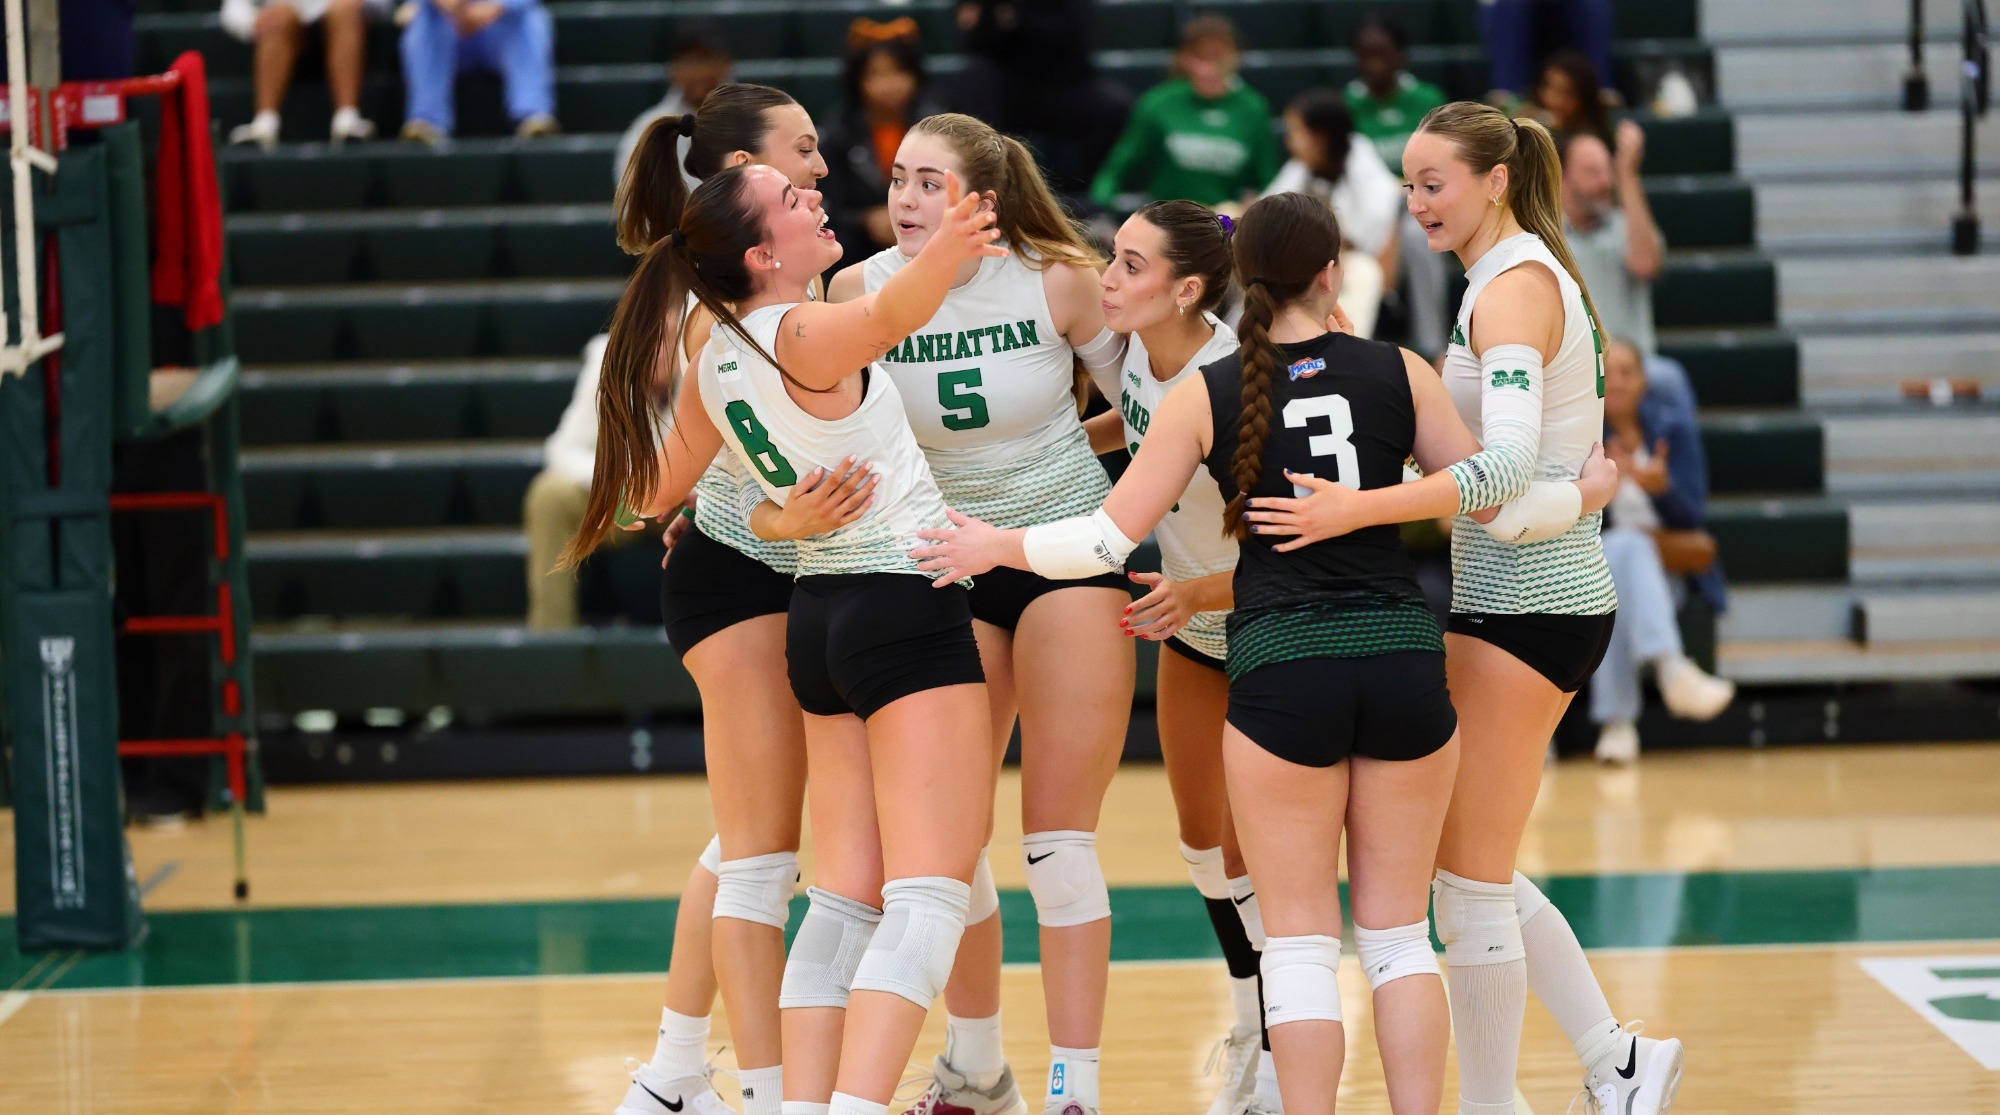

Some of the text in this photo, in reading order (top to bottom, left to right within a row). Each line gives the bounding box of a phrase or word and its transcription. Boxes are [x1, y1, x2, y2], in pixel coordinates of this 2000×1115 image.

[725, 399, 798, 488] 8
[937, 367, 990, 431] 5
[1282, 393, 1361, 499] 3
